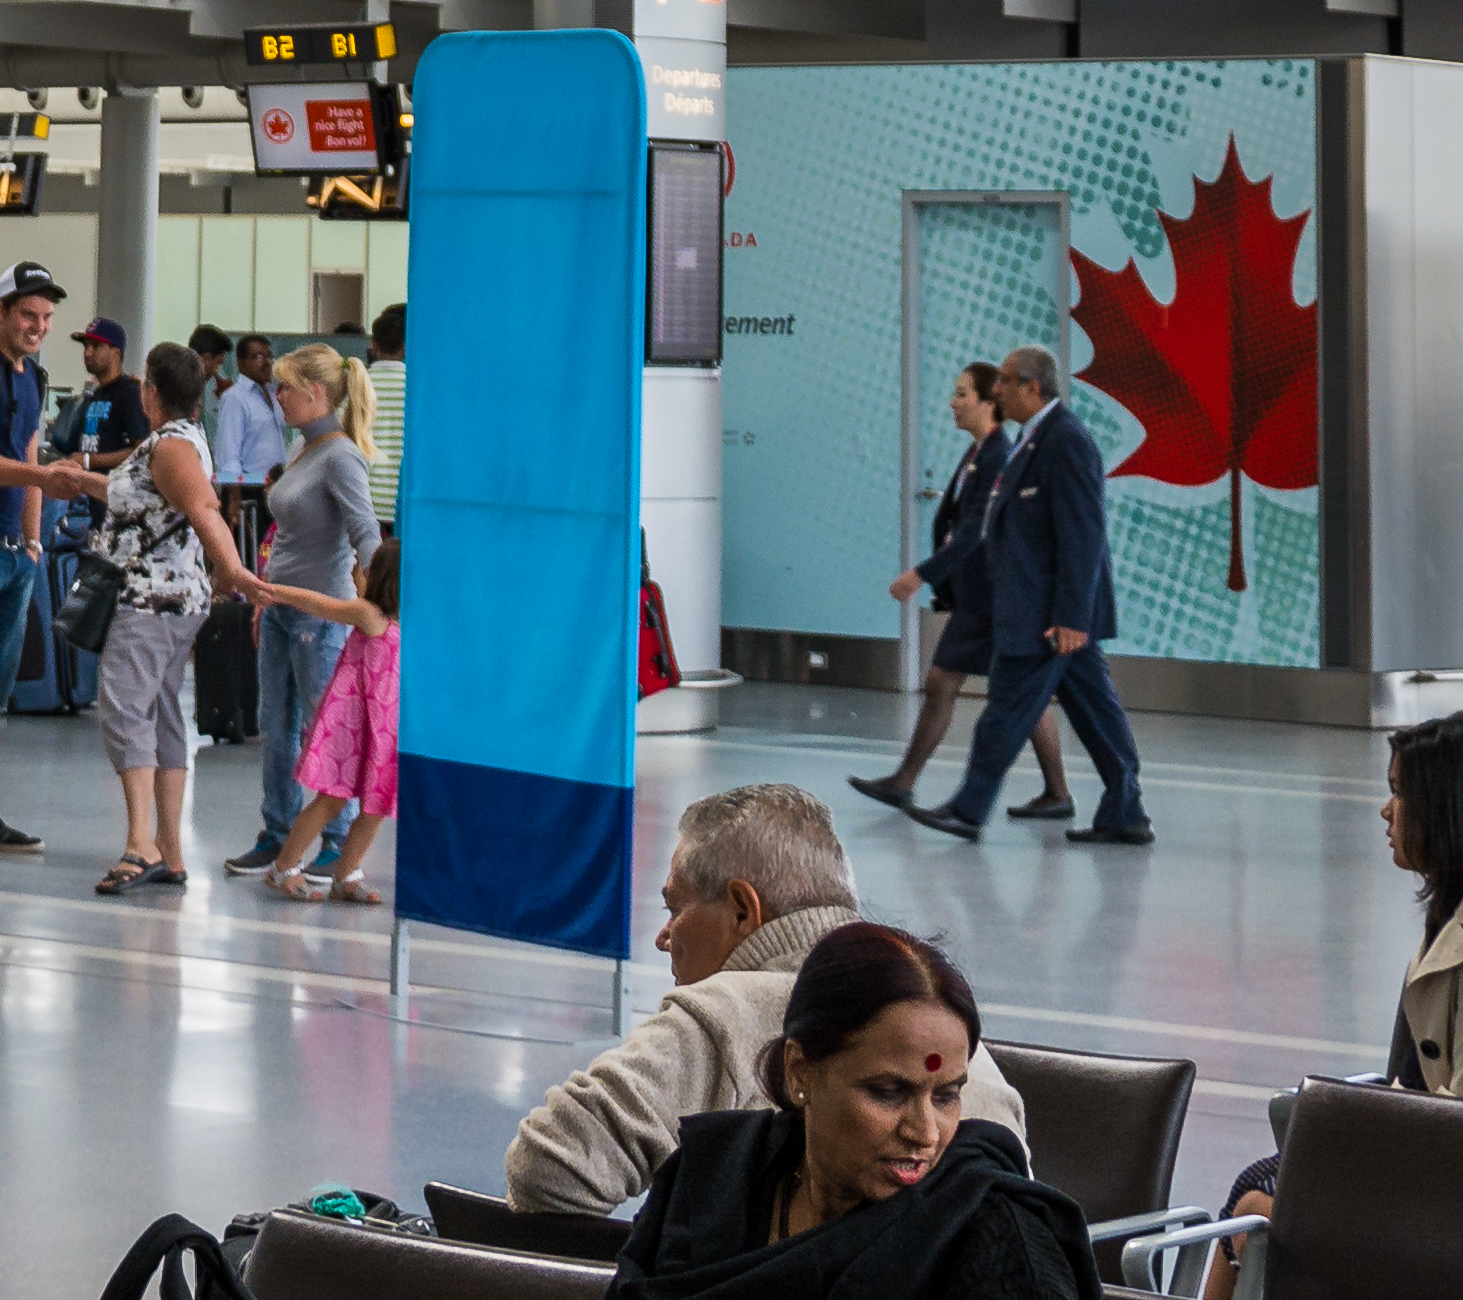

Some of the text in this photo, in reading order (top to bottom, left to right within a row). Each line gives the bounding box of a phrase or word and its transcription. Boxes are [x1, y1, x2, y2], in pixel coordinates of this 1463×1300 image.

[262, 33, 357, 60] B2 B1
[652, 64, 722, 90] Departures
[327, 106, 363, 117] Have a
[664, 92, 715, 116] Départs
[314, 118, 364, 134] nice flight
[325, 135, 346, 147] Bon
